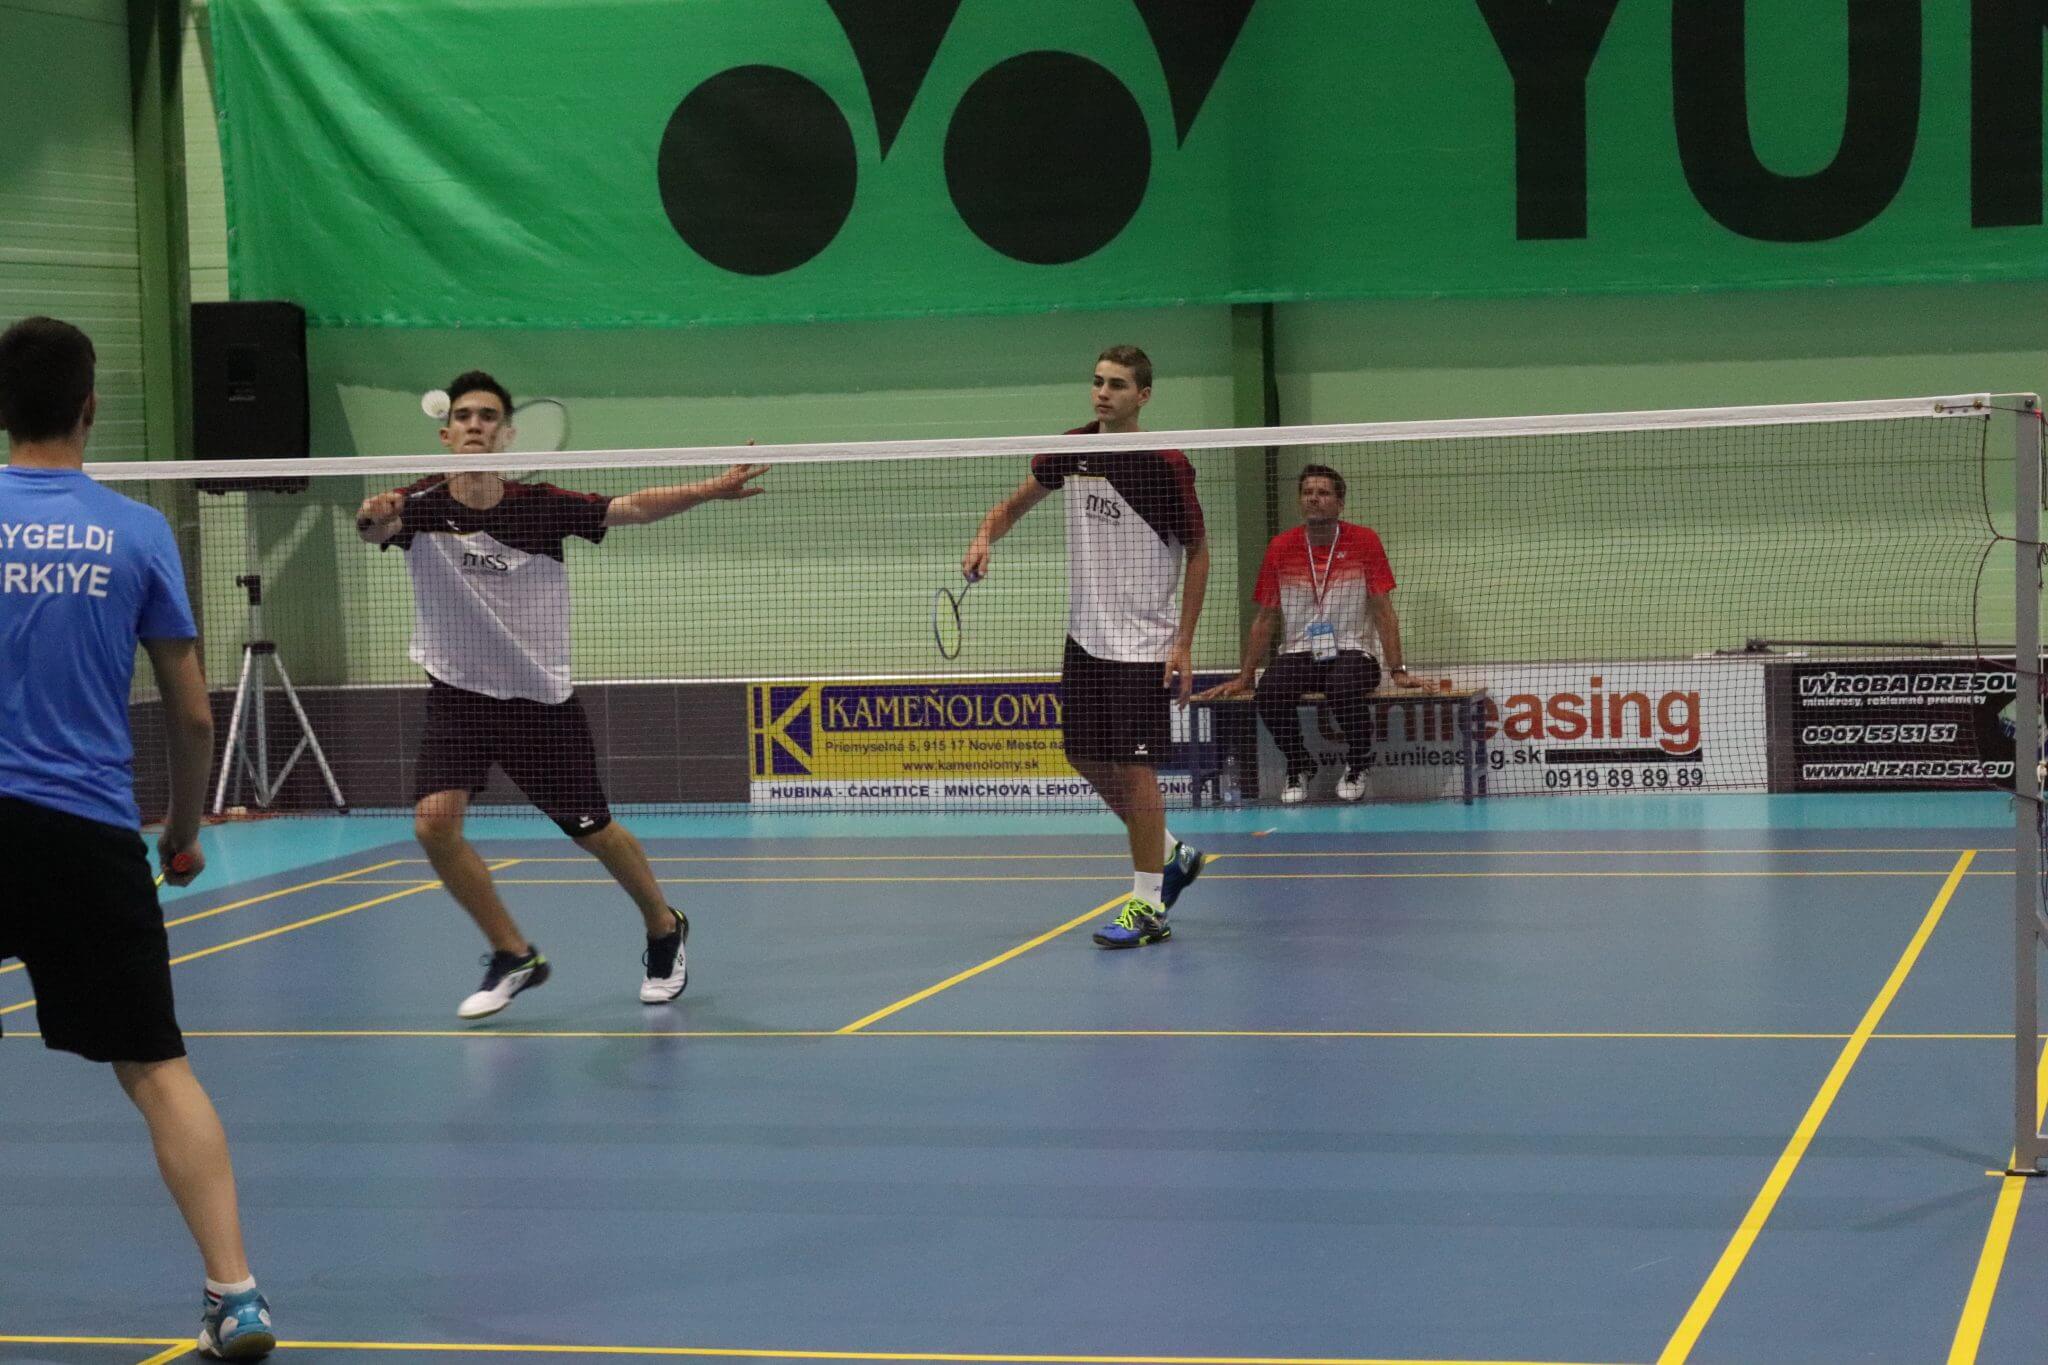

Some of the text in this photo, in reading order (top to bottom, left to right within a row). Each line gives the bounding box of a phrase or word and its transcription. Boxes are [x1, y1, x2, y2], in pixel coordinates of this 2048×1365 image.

[1801, 672, 1907, 695] VÝROBA
[1803, 724, 1957, 744] 0907 55 31 31
[924, 740, 945, 751] 915
[951, 740, 964, 750] 17
[1006, 739, 1046, 750] Mesto
[1545, 768, 1703, 788] 0919 89 89 89
[771, 787, 832, 798] HUBINA
